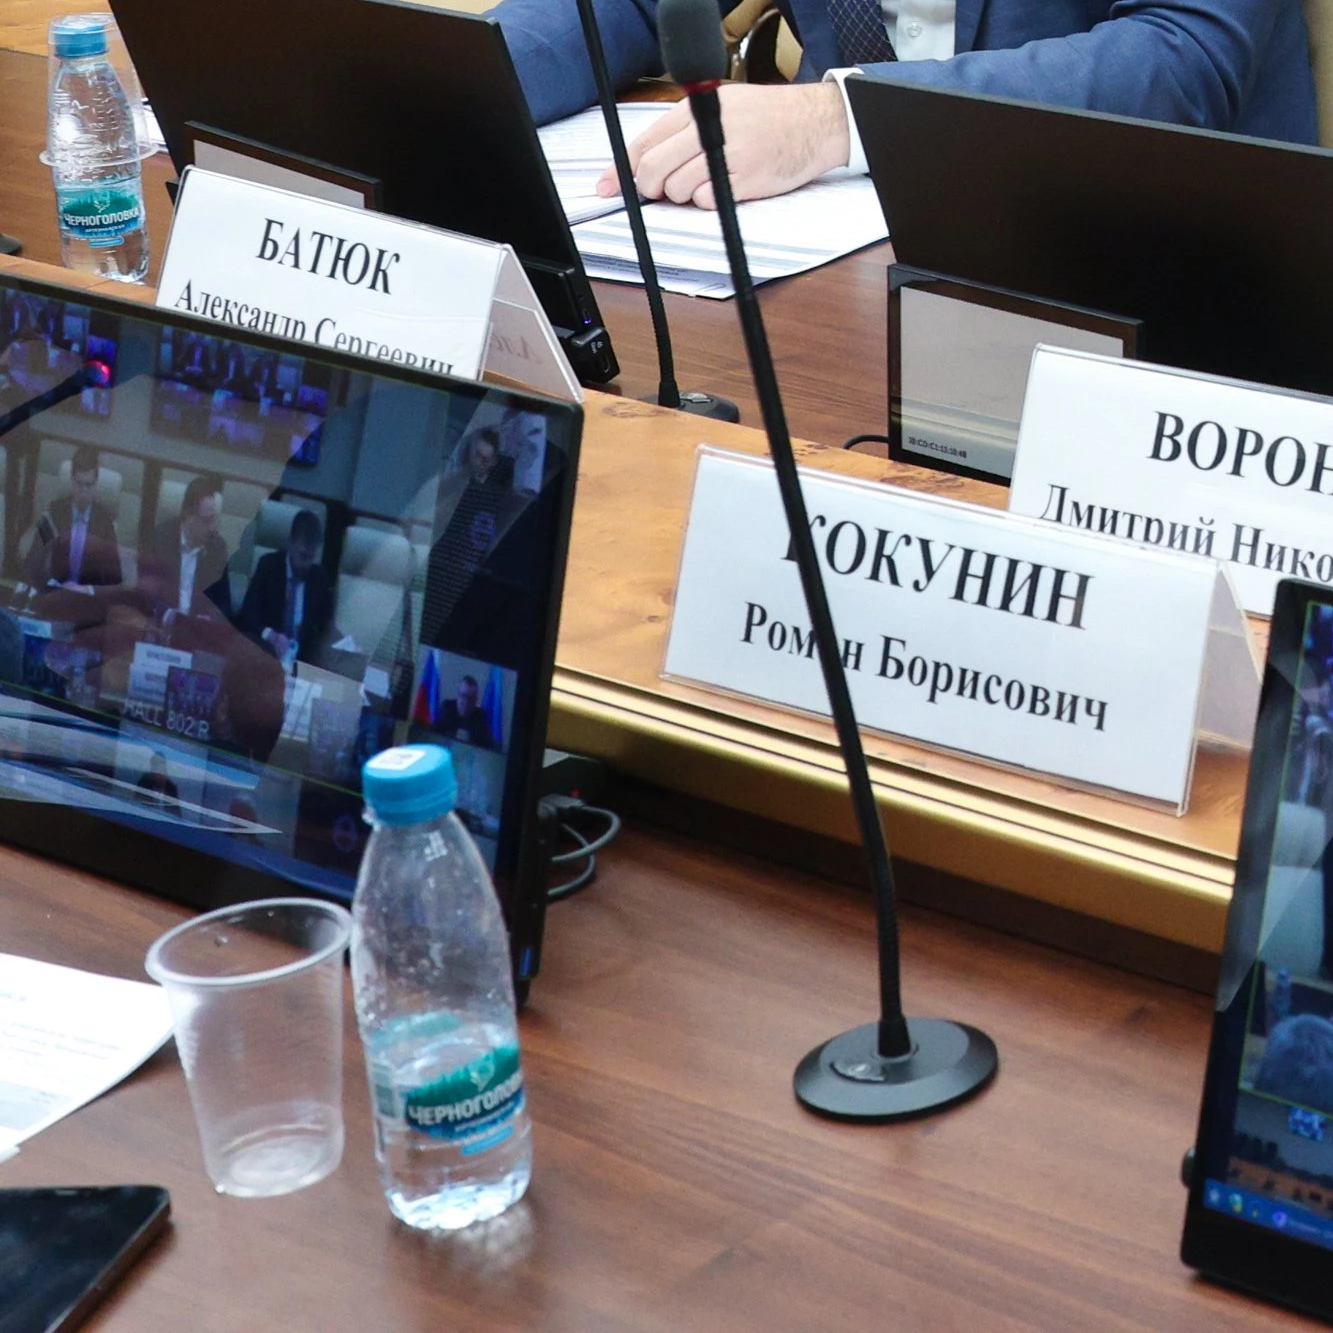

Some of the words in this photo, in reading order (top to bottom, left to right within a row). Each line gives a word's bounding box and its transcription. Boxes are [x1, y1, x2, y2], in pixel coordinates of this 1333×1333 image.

[63, 207, 140, 226] ЧЕРНОГОЛОВКА
[255, 217, 401, 295] БАТЮК
[174, 278, 307, 342] Александр
[1039, 483, 1217, 558] Дмитрий
[739, 600, 866, 672] Ромн
[875, 634, 1109, 733] Борисович
